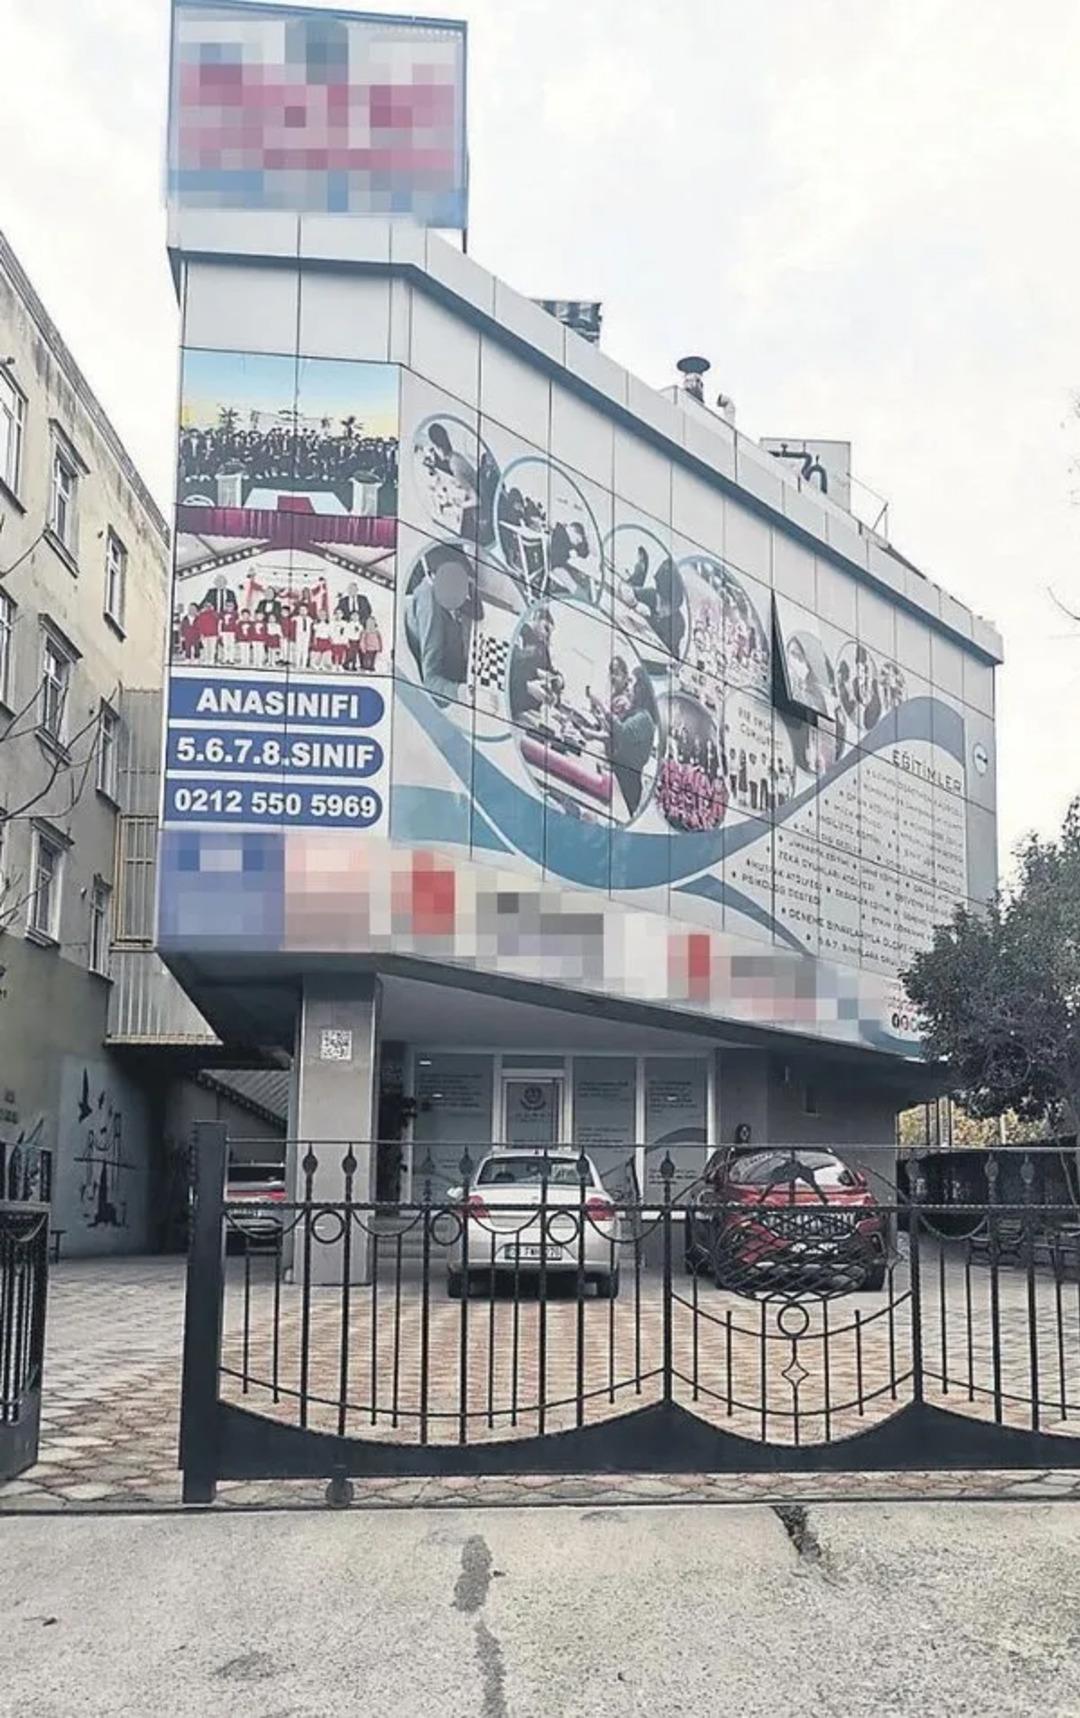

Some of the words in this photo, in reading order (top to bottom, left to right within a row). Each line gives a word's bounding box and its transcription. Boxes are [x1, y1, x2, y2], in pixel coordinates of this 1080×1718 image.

[196, 688, 359, 719] ANASINIFI
[177, 737, 375, 768] 5.6.7.8.SINIF
[175, 788, 242, 812] 0212
[251, 792, 301, 814] 550
[310, 795, 376, 818] 5969
